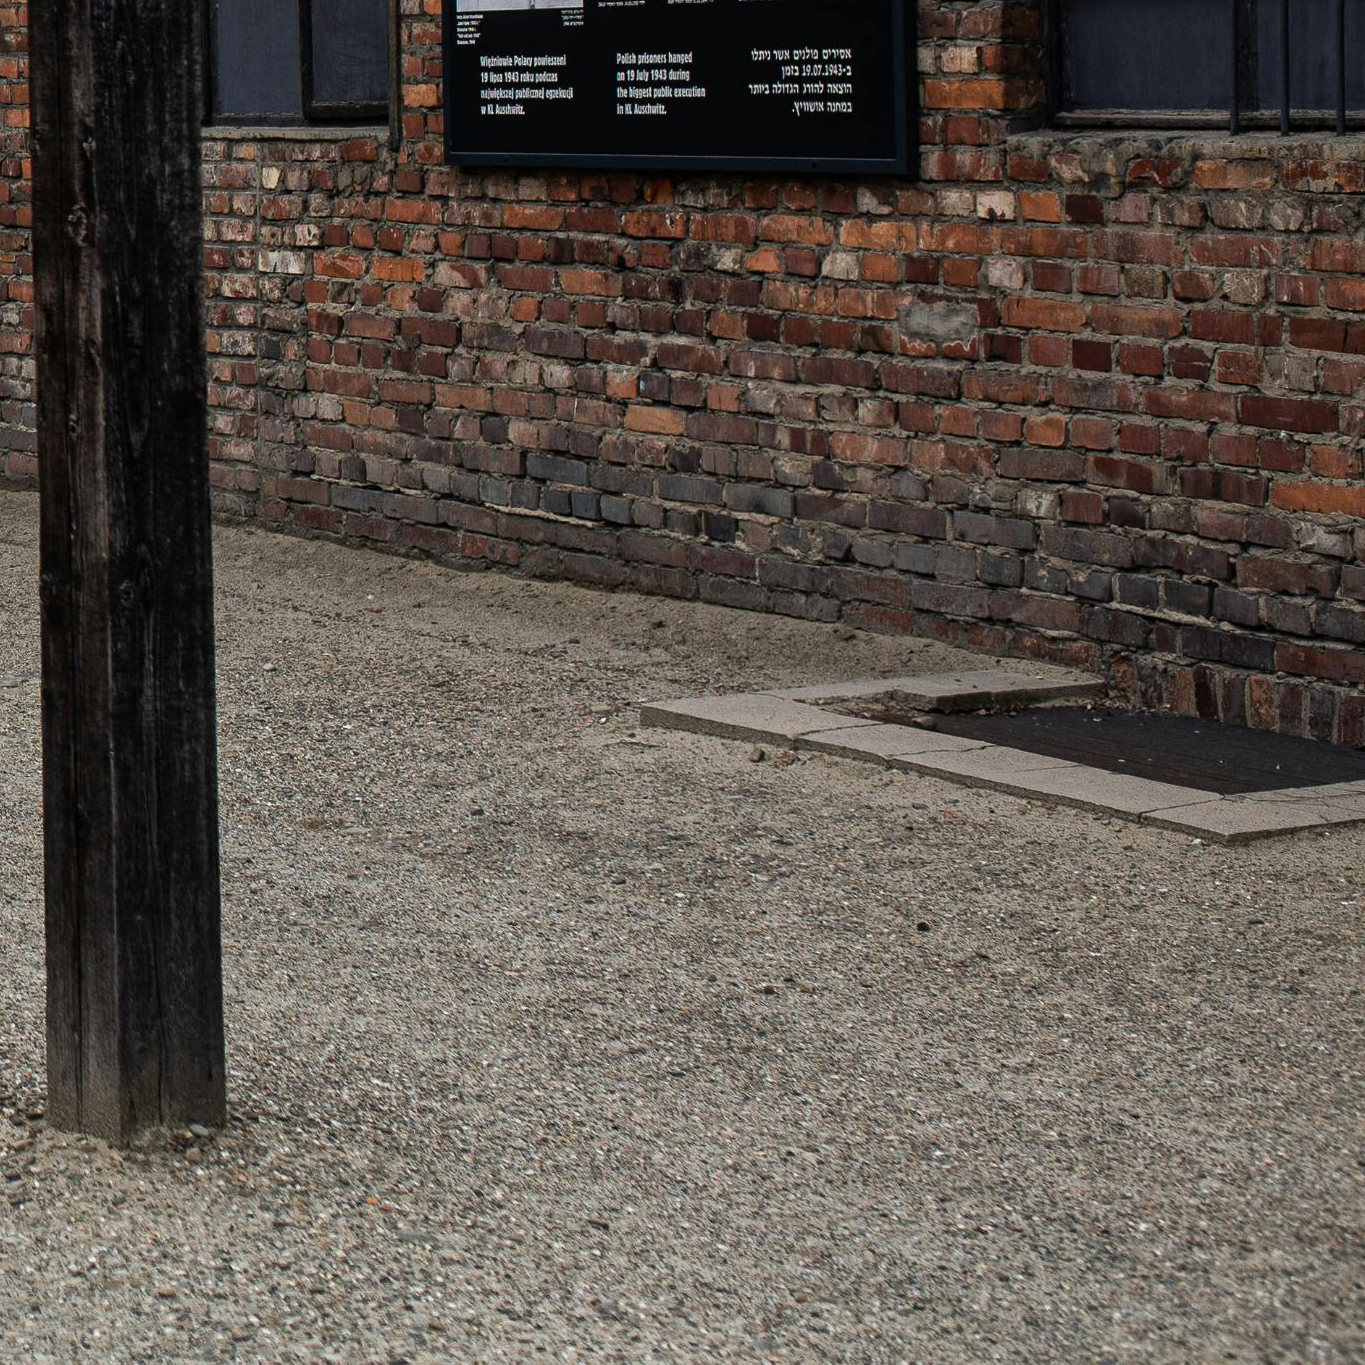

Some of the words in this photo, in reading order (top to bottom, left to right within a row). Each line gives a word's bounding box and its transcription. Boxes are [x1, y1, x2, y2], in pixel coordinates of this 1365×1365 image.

[617, 53, 636, 64] Polish
[638, 52, 666, 65] prisoners
[669, 52, 692, 64] hanged
[751, 48, 771, 60] ניתלו
[773, 50, 789, 60] אשר
[793, 47, 818, 60] פולנים
[822, 48, 851, 59] אסירים
[514, 55, 532, 67] Polacy
[534, 54, 566, 67] powieszeni
[481, 72, 488, 82] 19
[489, 72, 503, 83] lipca
[505, 72, 519, 82] 1943
[520, 72, 534, 82] roku
[535, 72, 557, 83] podczas
[617, 71, 625, 81] on
[627, 70, 634, 80] 19
[636, 70, 649, 81] July
[651, 69, 666, 80] 1943
[669, 69, 689, 81] during
[782, 66, 799, 79] בזמן
[515, 88, 544, 99] publicznej
[546, 87, 573, 99] egzekucji
[617, 87, 627, 97] the
[629, 86, 652, 98] biggest
[654, 86, 672, 98] public
[674, 86, 705, 97] execution
[749, 84, 769, 94] ביותר
[772, 82, 799, 94] הגדולה
[803, 82, 823, 95] להורג
[827, 83, 852, 94] הוצאה
[488, 104, 494, 114] KL
[495, 104, 525, 114] Auschwitz.
[617, 103, 623, 114] in
[625, 104, 632, 114] KL
[634, 103, 666, 114] Auschwitz.
[792, 101, 824, 117] אושוויץ.
[827, 102, 852, 112] במחנה
